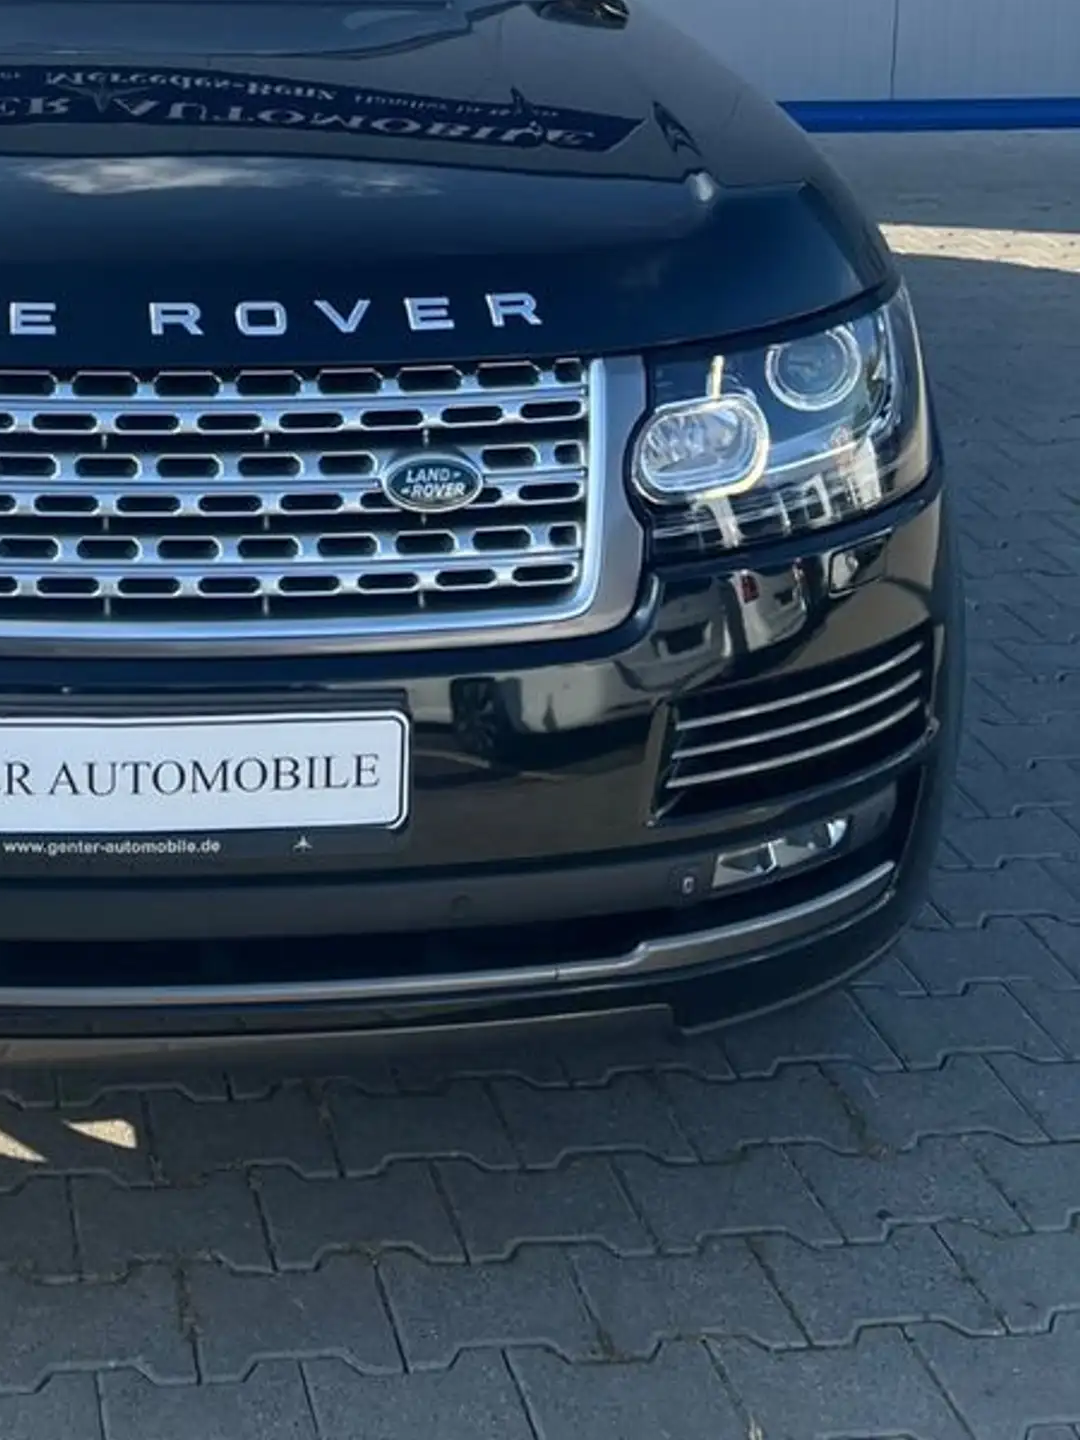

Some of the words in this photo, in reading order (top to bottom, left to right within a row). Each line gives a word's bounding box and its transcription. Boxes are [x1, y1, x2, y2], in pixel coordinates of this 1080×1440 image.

[149, 292, 543, 337] ROVER
[406, 467, 451, 483] LAND
[410, 482, 466, 499] ROVER
[48, 753, 380, 797] AUTOMOBILE
[3, 838, 221, 856] www.genter-automobile.de
